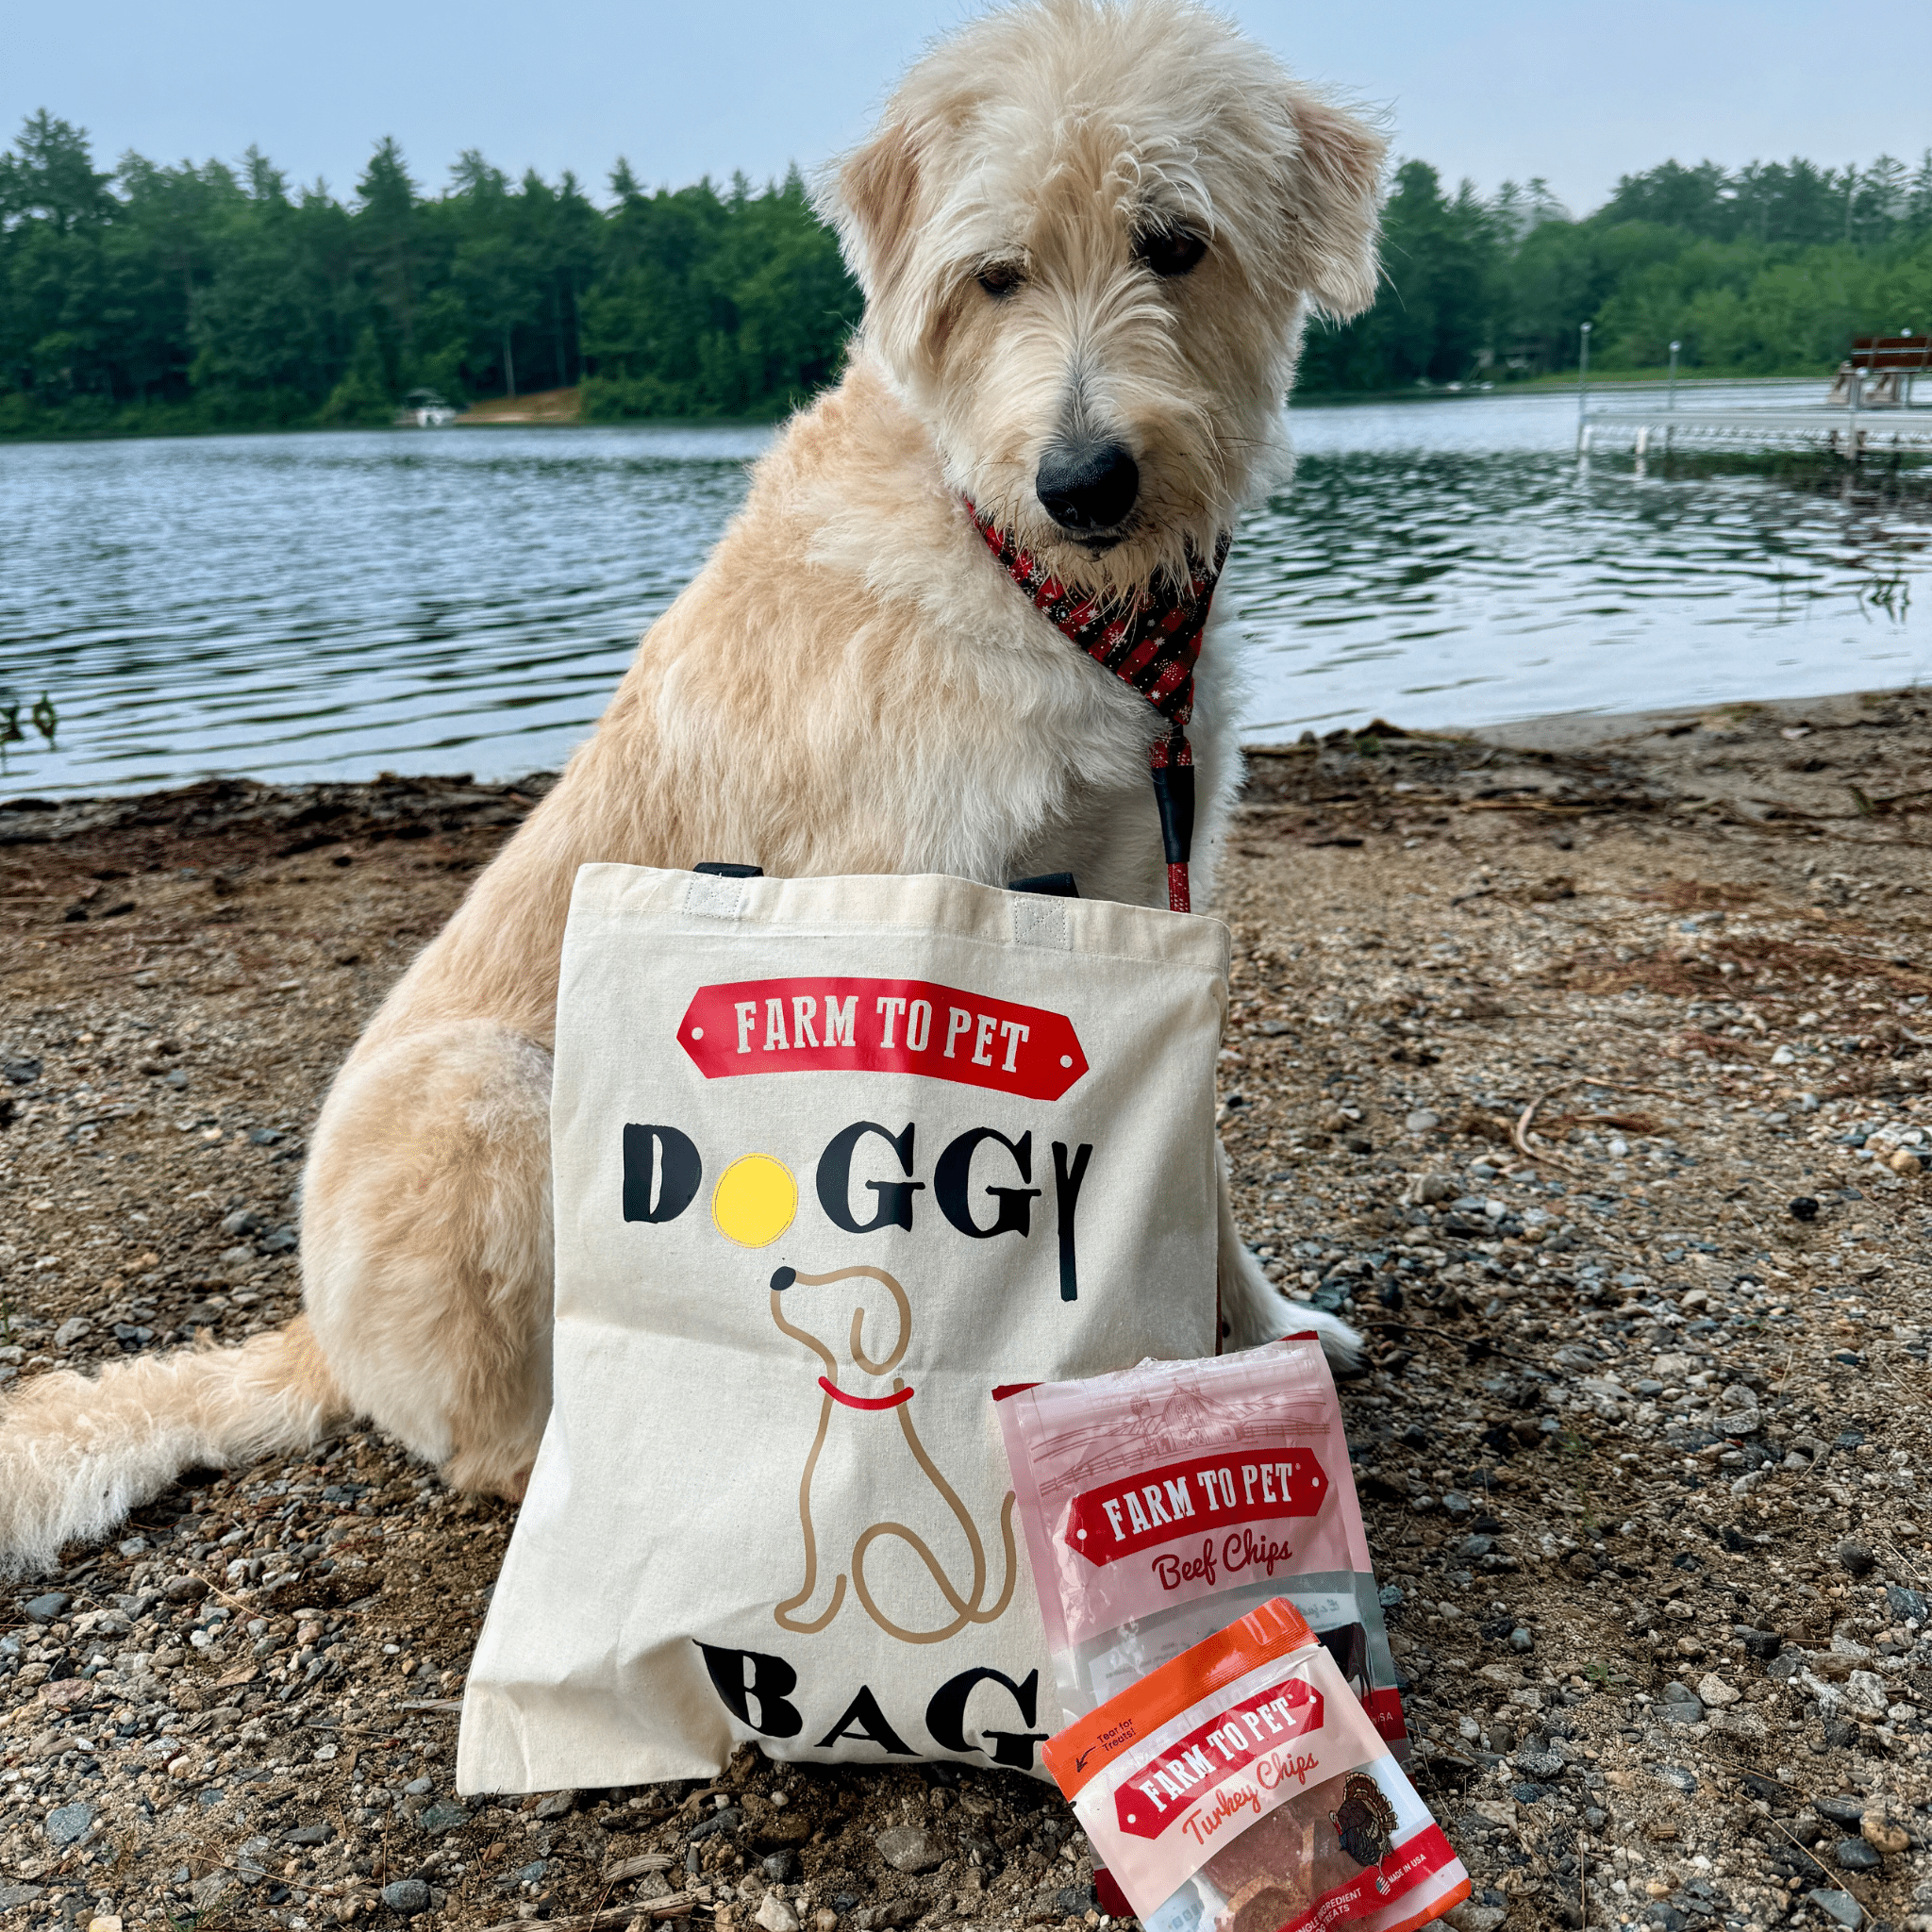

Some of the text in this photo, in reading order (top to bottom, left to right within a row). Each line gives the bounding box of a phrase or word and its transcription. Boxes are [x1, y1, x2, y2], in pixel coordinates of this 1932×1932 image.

[734, 995, 1030, 1074] FARM TO PET
[1102, 1476, 1195, 1542] FARM
[1197, 1468, 1237, 1511] TO
[1152, 1528, 1292, 1591] Beef Chips
[691, 1638, 1050, 1772] BAG
[1097, 1718, 1133, 1743] Tear for
[1102, 1727, 1137, 1752] Treats!
[1139, 1696, 1296, 1813] FARM TO PET
[1182, 1752, 1319, 1845] Turkey Chips
[1387, 1853, 1427, 1884] MADE IN USA
[1295, 1916, 1320, 1932] NGLE
